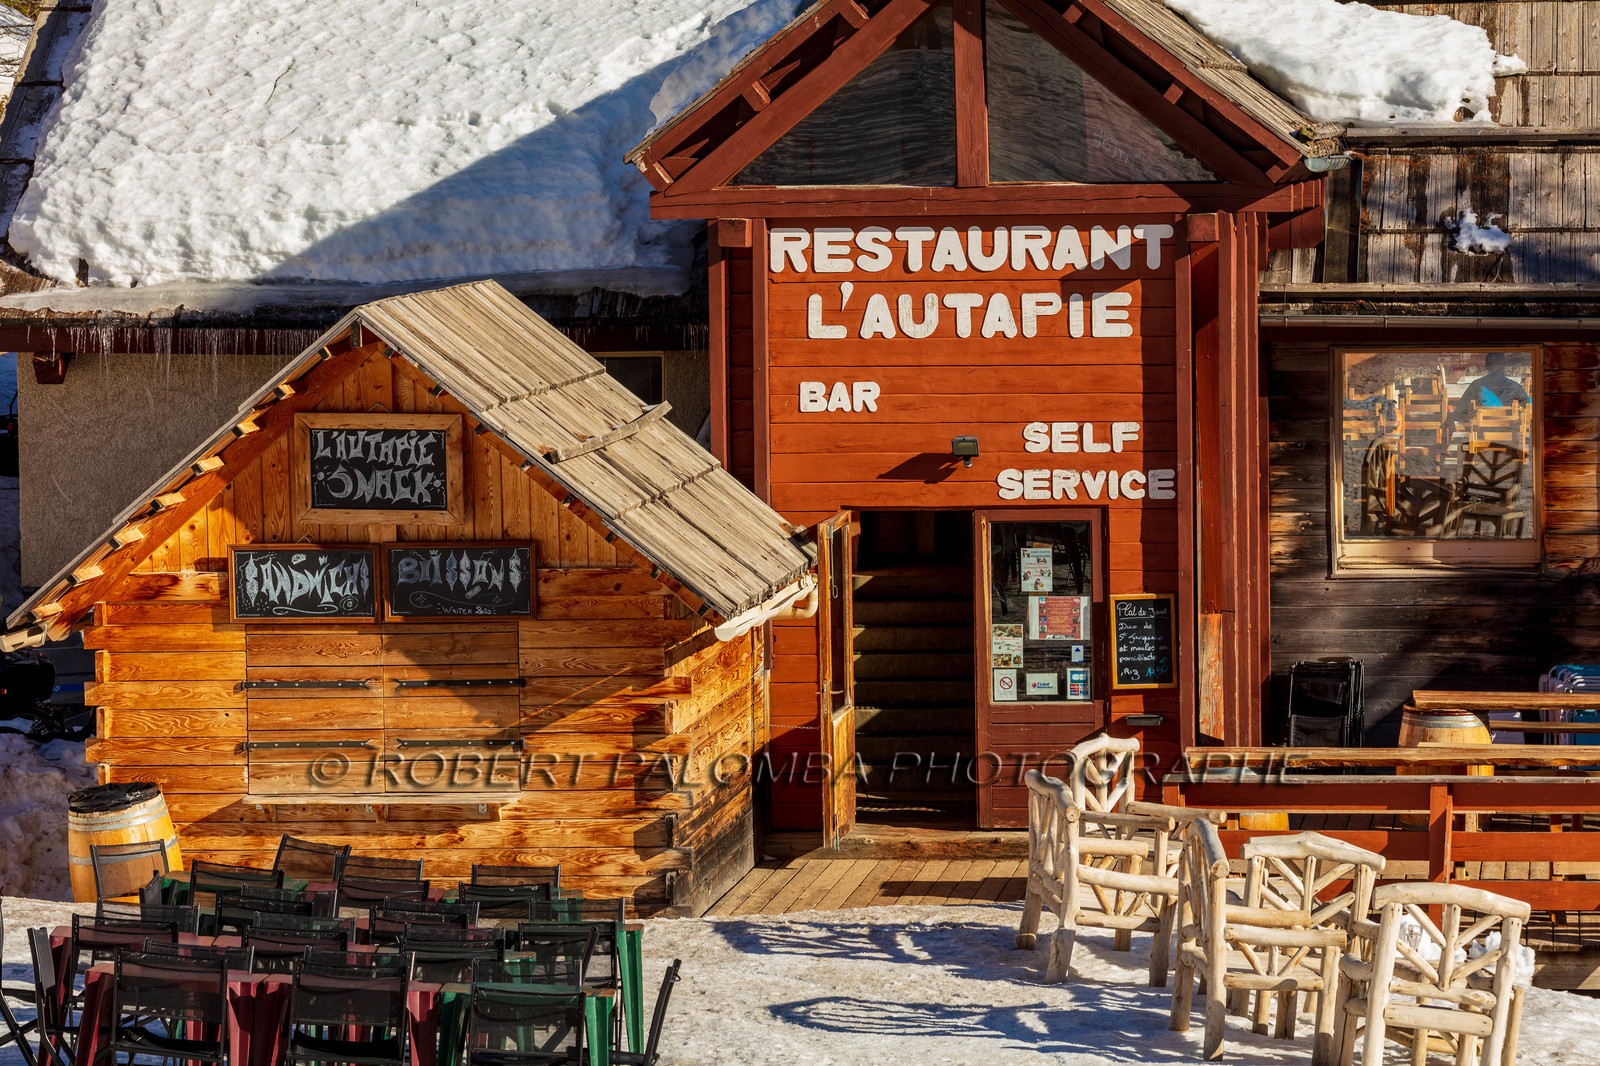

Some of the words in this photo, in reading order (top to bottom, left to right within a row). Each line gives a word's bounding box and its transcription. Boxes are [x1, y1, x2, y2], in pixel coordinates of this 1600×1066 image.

[769, 224, 1175, 273] RESTAURANT
[807, 281, 1133, 340] L'AUTAPIE
[799, 381, 880, 413] BAR
[1023, 421, 1140, 453] SELF
[326, 464, 435, 504] SNACK
[997, 468, 1176, 500] SERVICE
[397, 548, 522, 593] BOISSONS
[1117, 602, 1137, 616] Plat
[1118, 644, 1128, 653] et
